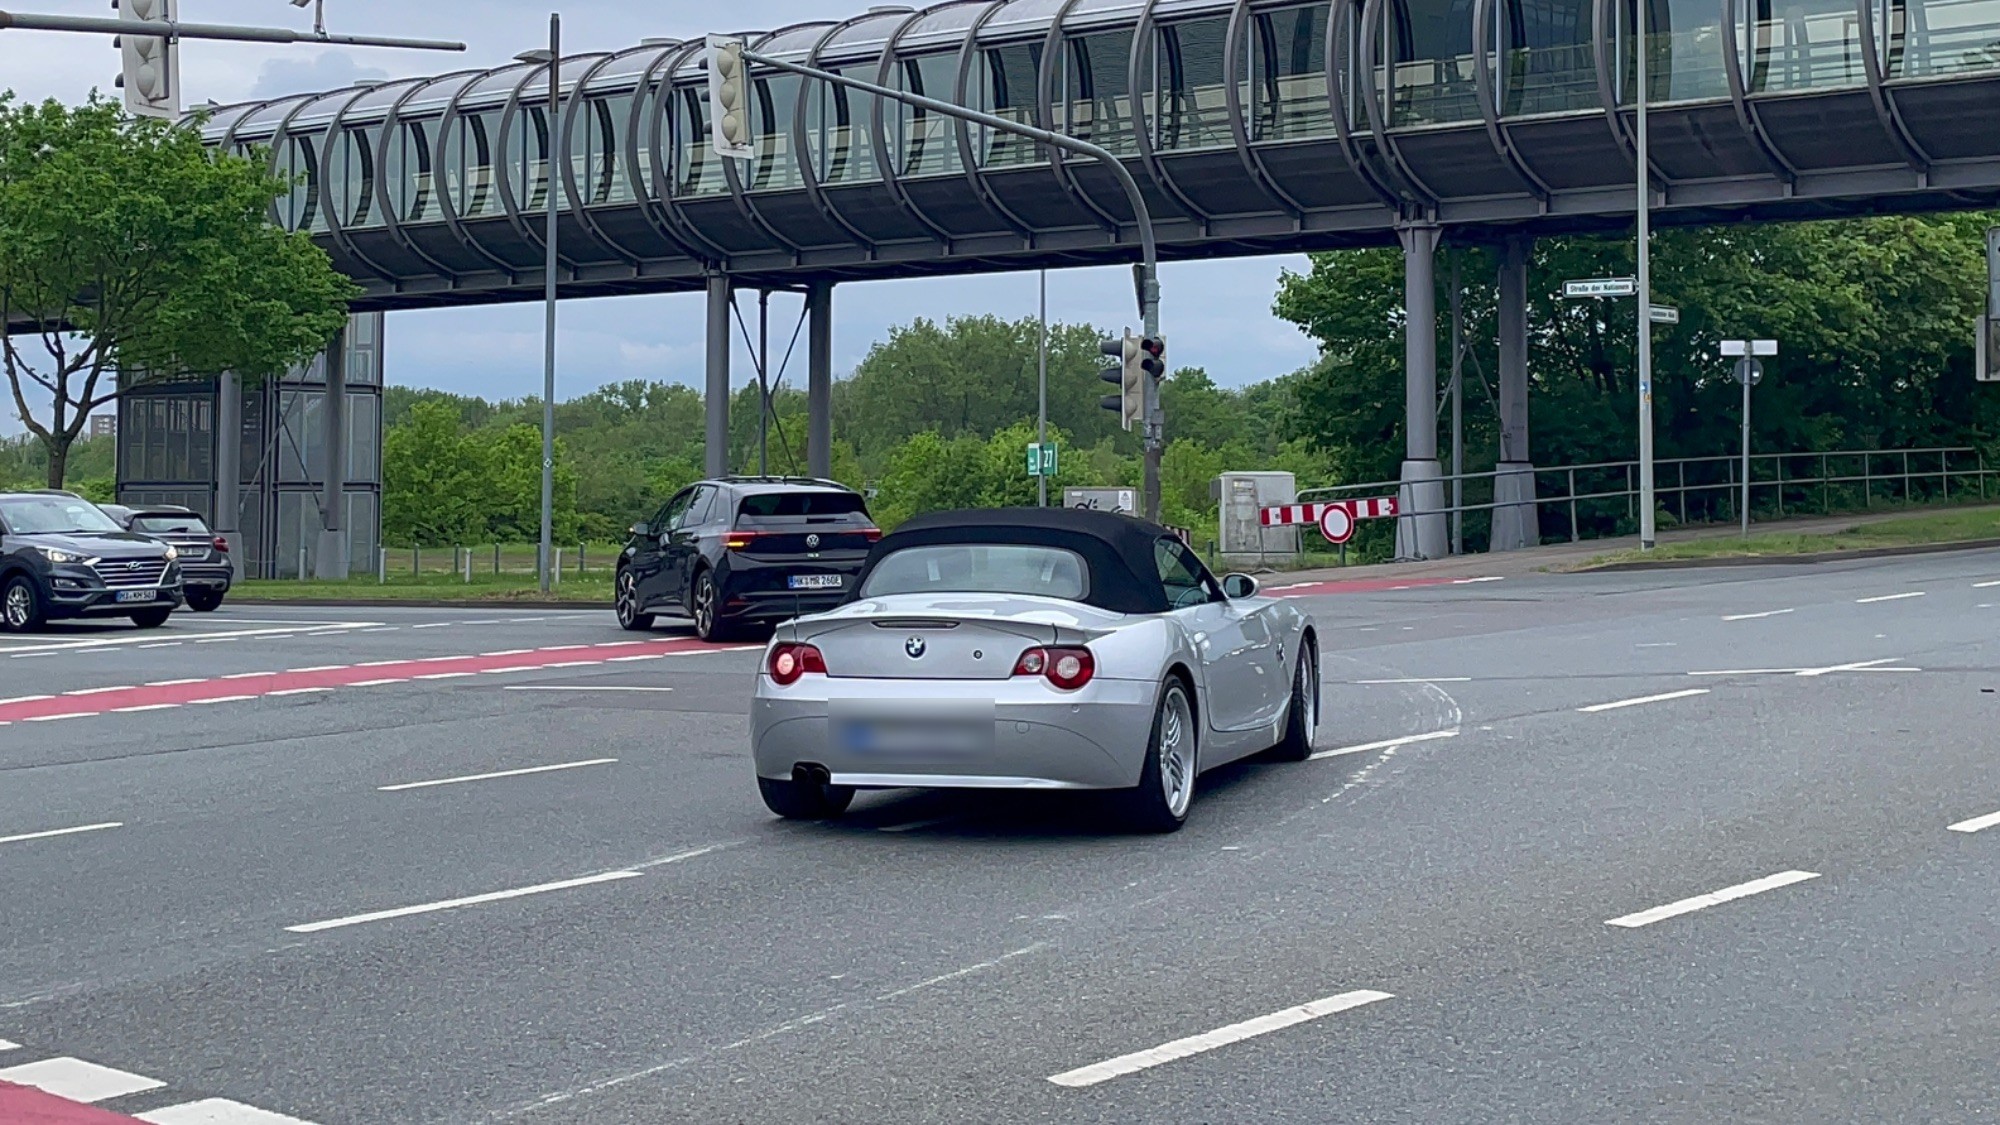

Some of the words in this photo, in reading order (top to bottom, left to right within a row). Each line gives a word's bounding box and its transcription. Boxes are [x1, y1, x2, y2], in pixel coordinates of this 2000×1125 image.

[1570, 284, 1589, 292] Straße
[1603, 283, 1630, 291] Nationen
[1043, 450, 1053, 468] 27
